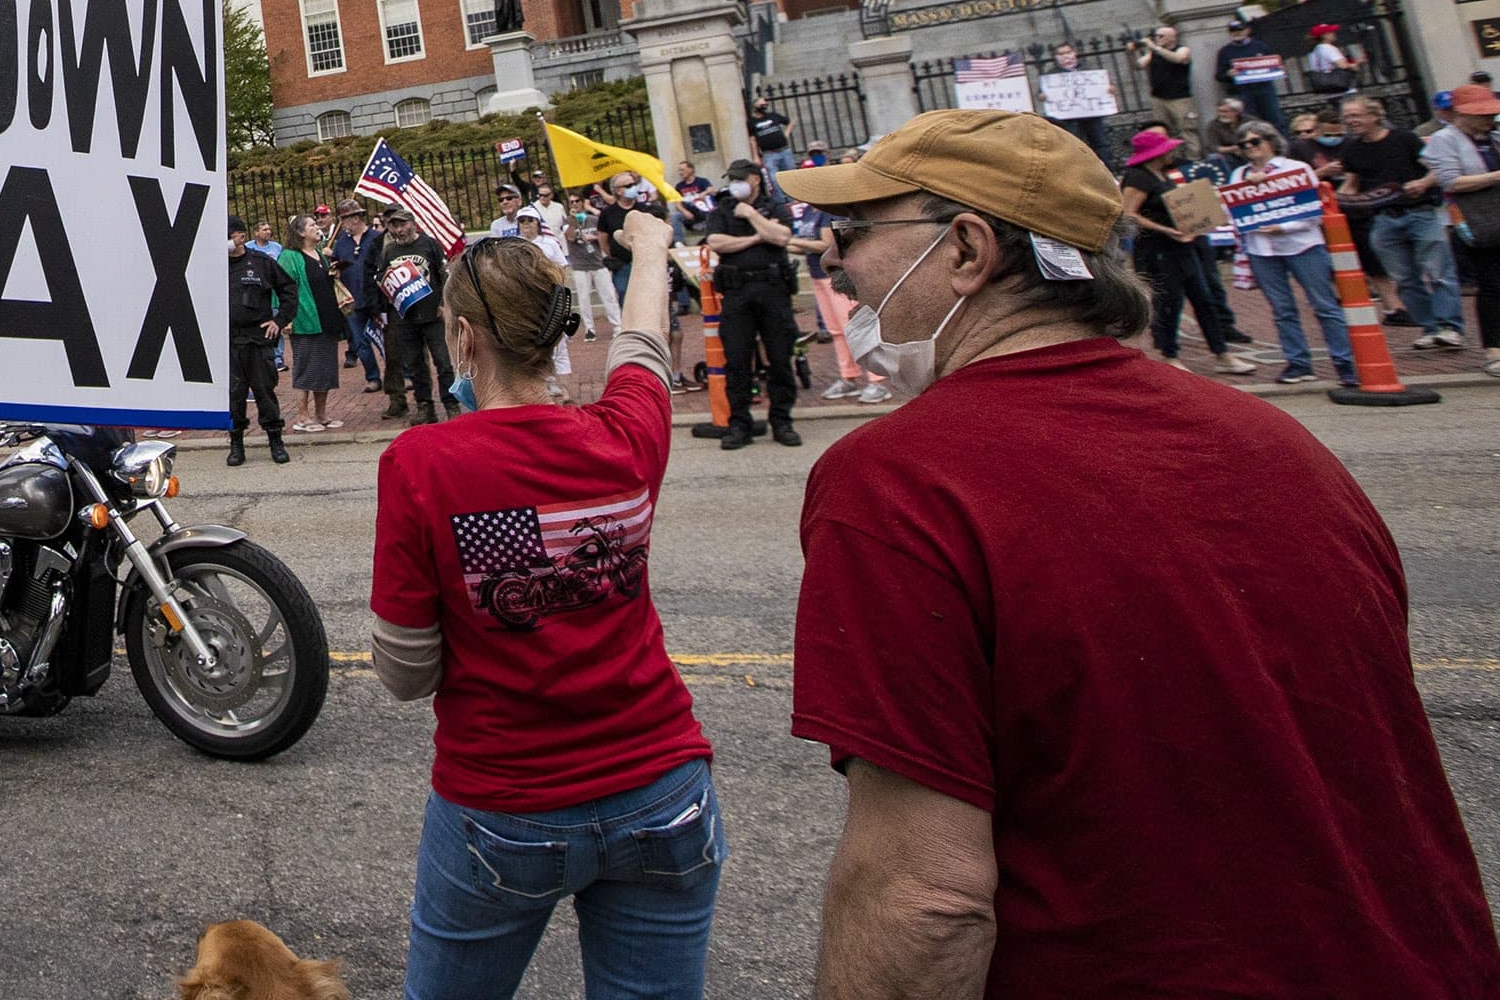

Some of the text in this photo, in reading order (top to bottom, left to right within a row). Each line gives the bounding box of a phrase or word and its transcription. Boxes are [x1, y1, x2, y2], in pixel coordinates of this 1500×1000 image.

[501, 139, 520, 152] END
[379, 165, 400, 184] 76
[1221, 173, 1309, 203] TYRANNY
[1234, 200, 1323, 227] LEADERSHIP
[1268, 196, 1297, 210] NOT
[385, 266, 411, 296] END
